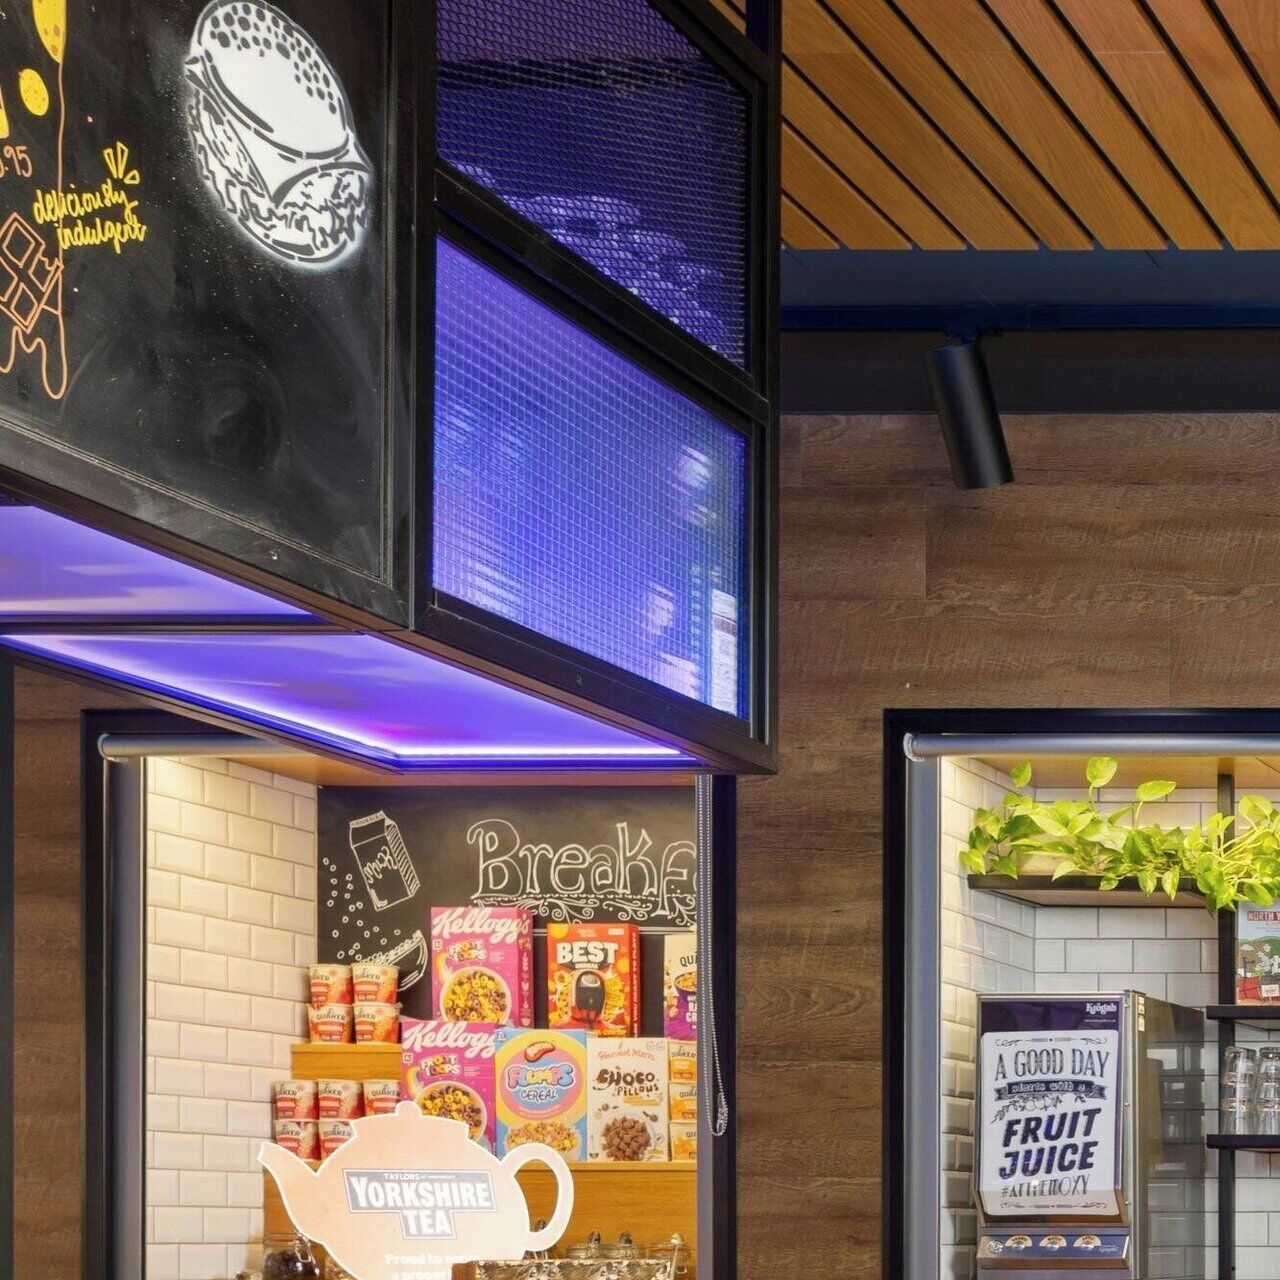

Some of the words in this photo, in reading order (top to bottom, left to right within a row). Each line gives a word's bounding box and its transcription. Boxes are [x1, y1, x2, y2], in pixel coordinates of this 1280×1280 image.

[33, 178, 139, 226] deliciously
[56, 217, 147, 254] indulgent
[467, 818, 697, 917] Breakf
[431, 907, 529, 944] Kellogg's
[1248, 911, 1275, 921] NORTH
[556, 941, 619, 965] BEST
[593, 1068, 656, 1091] CHOCO
[995, 1053, 1007, 1082] A
[1015, 1048, 1064, 1077] GOOD
[1072, 1048, 1110, 1078] DAY
[520, 1089, 557, 1102] CEREAL
[1011, 1082, 1045, 1093] starts
[1050, 1082, 1074, 1091] with
[1077, 1083, 1086, 1092] a
[1002, 1108, 1102, 1148] FRUIT
[999, 1141, 1098, 1180] JUICE
[384, 1172, 420, 1181] TAYLORS
[349, 1176, 491, 1208] YORKSHIRE
[402, 1209, 452, 1235] TEA
[386, 1253, 425, 1265] Proud
[428, 1254, 442, 1263] to
